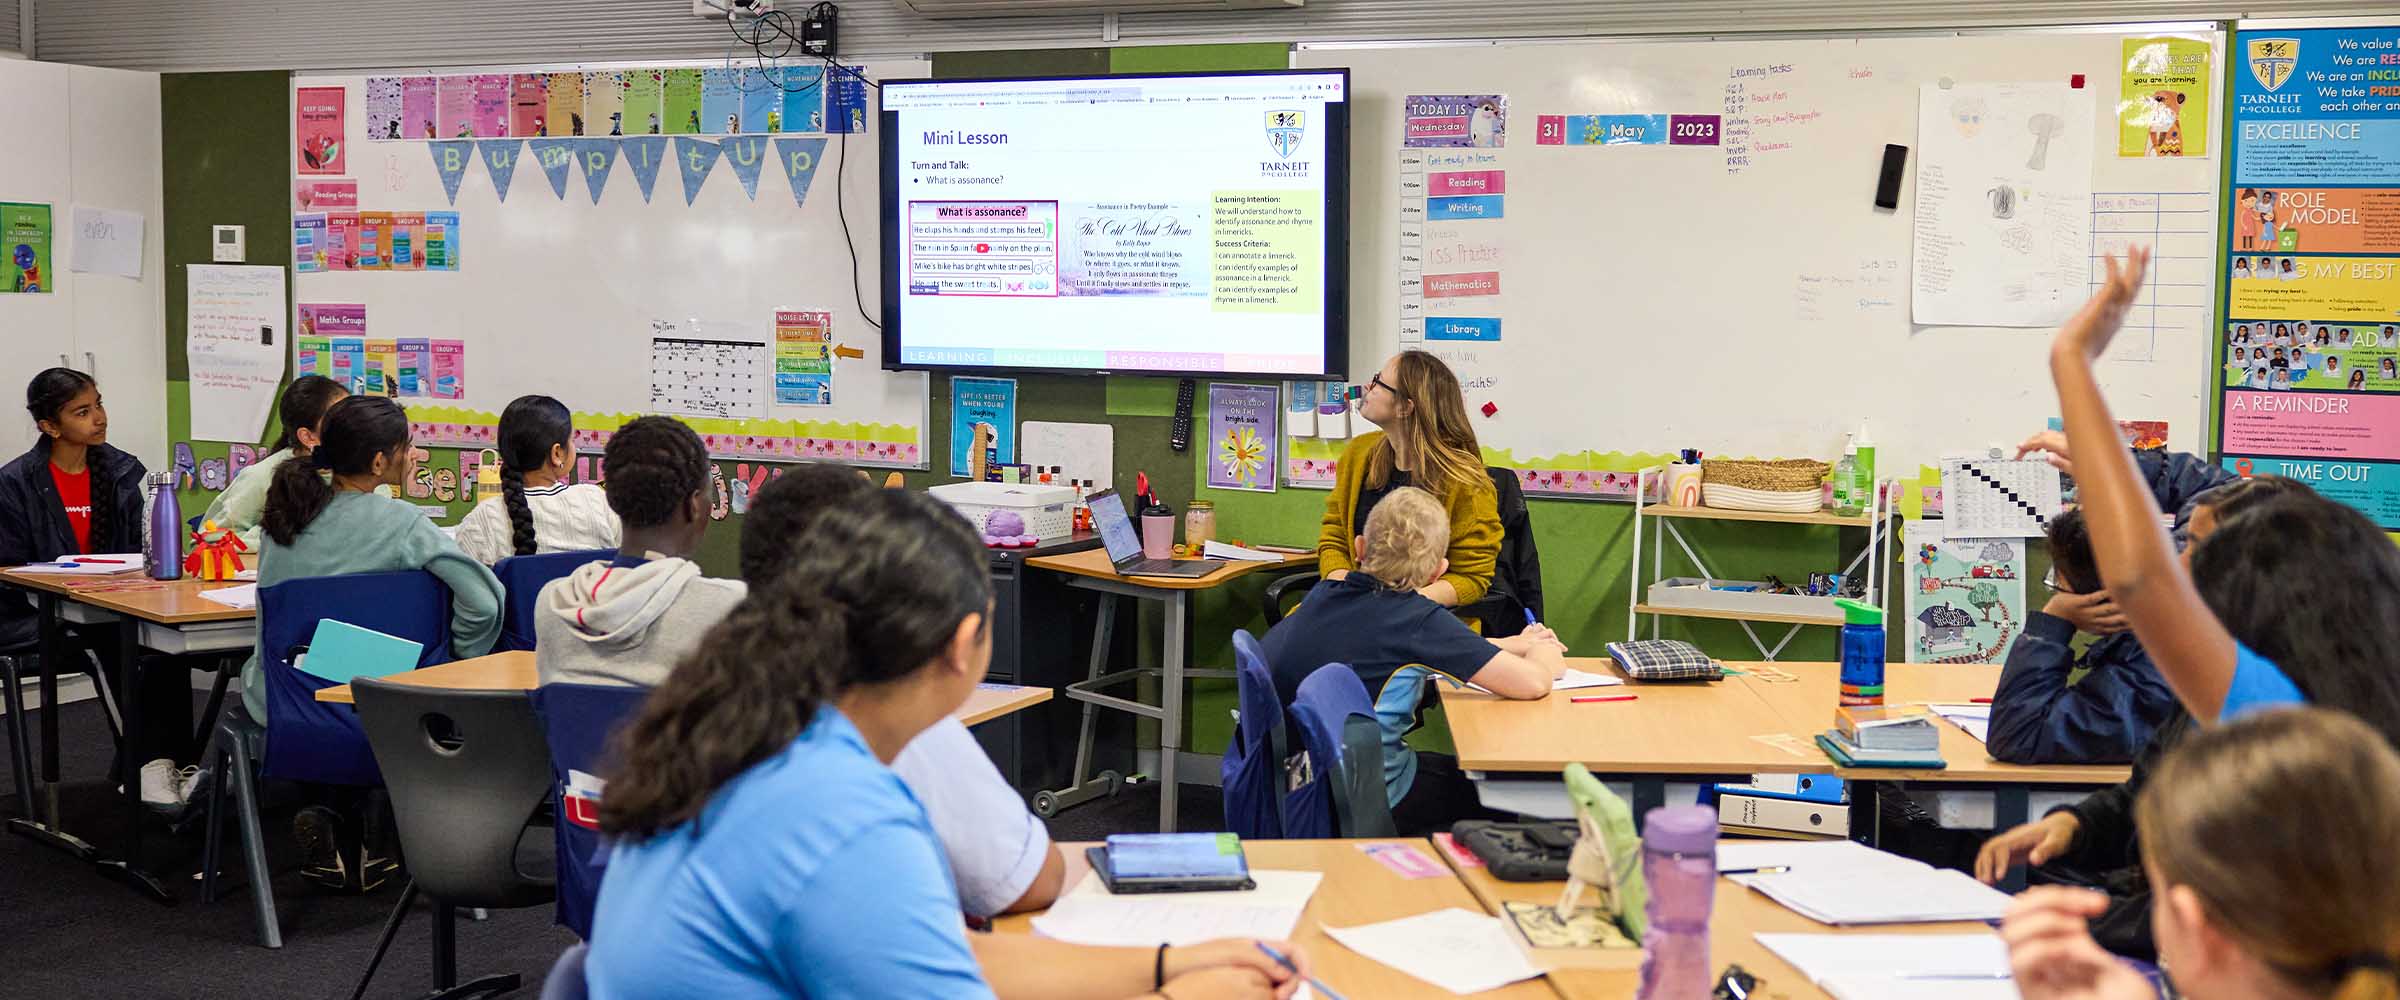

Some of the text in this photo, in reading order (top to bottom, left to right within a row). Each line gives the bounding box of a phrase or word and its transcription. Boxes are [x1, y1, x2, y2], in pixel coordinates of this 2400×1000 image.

[2338, 38, 2393, 49] We value
[2333, 55, 2353, 65] We
[2357, 57, 2376, 65] are
[1731, 66, 1766, 80] Learning
[2306, 71, 2325, 82] We
[2329, 73, 2346, 81] are
[2351, 73, 2364, 81] an
[2317, 87, 2337, 97] We
[2342, 86, 2366, 97] take
[2240, 94, 2302, 104] TARNEIT
[1412, 104, 1466, 115] TODAY IS
[2320, 100, 2381, 112] each other
[1411, 124, 1465, 132] Wednesday
[1543, 124, 1714, 140] 31 May 2023
[2246, 123, 2361, 140] EXCELLENCE
[923, 131, 1008, 145] Mini Lesson
[912, 161, 969, 170] Turn and Talk:
[1260, 162, 1310, 171] TARNEIT
[926, 175, 1004, 185] What is assonance?
[1449, 178, 1486, 189] Reading
[1216, 196, 1246, 205] Learning
[2280, 192, 2326, 209] ROLE
[939, 207, 1026, 217] What is assonance?
[1448, 203, 1483, 215] Writing
[1216, 218, 1240, 226] identify
[2290, 209, 2360, 225] MODEL
[953, 263, 965, 271] has
[1232, 264, 1256, 272] identify
[1258, 264, 1289, 272] examples
[2314, 263, 2346, 279] MY
[2352, 264, 2395, 279] BEST
[1232, 286, 1256, 294] identify
[1258, 286, 1289, 294] examples
[1431, 280, 1492, 291] Mathematics
[320, 316, 340, 324] Maths
[1446, 324, 1481, 337] Library
[909, 351, 1219, 370] LEARNING RESPONSIBLE
[2232, 395, 2349, 414] A REMINDER
[1225, 415, 1245, 424] bright
[2280, 463, 2371, 482] TIME OUT
